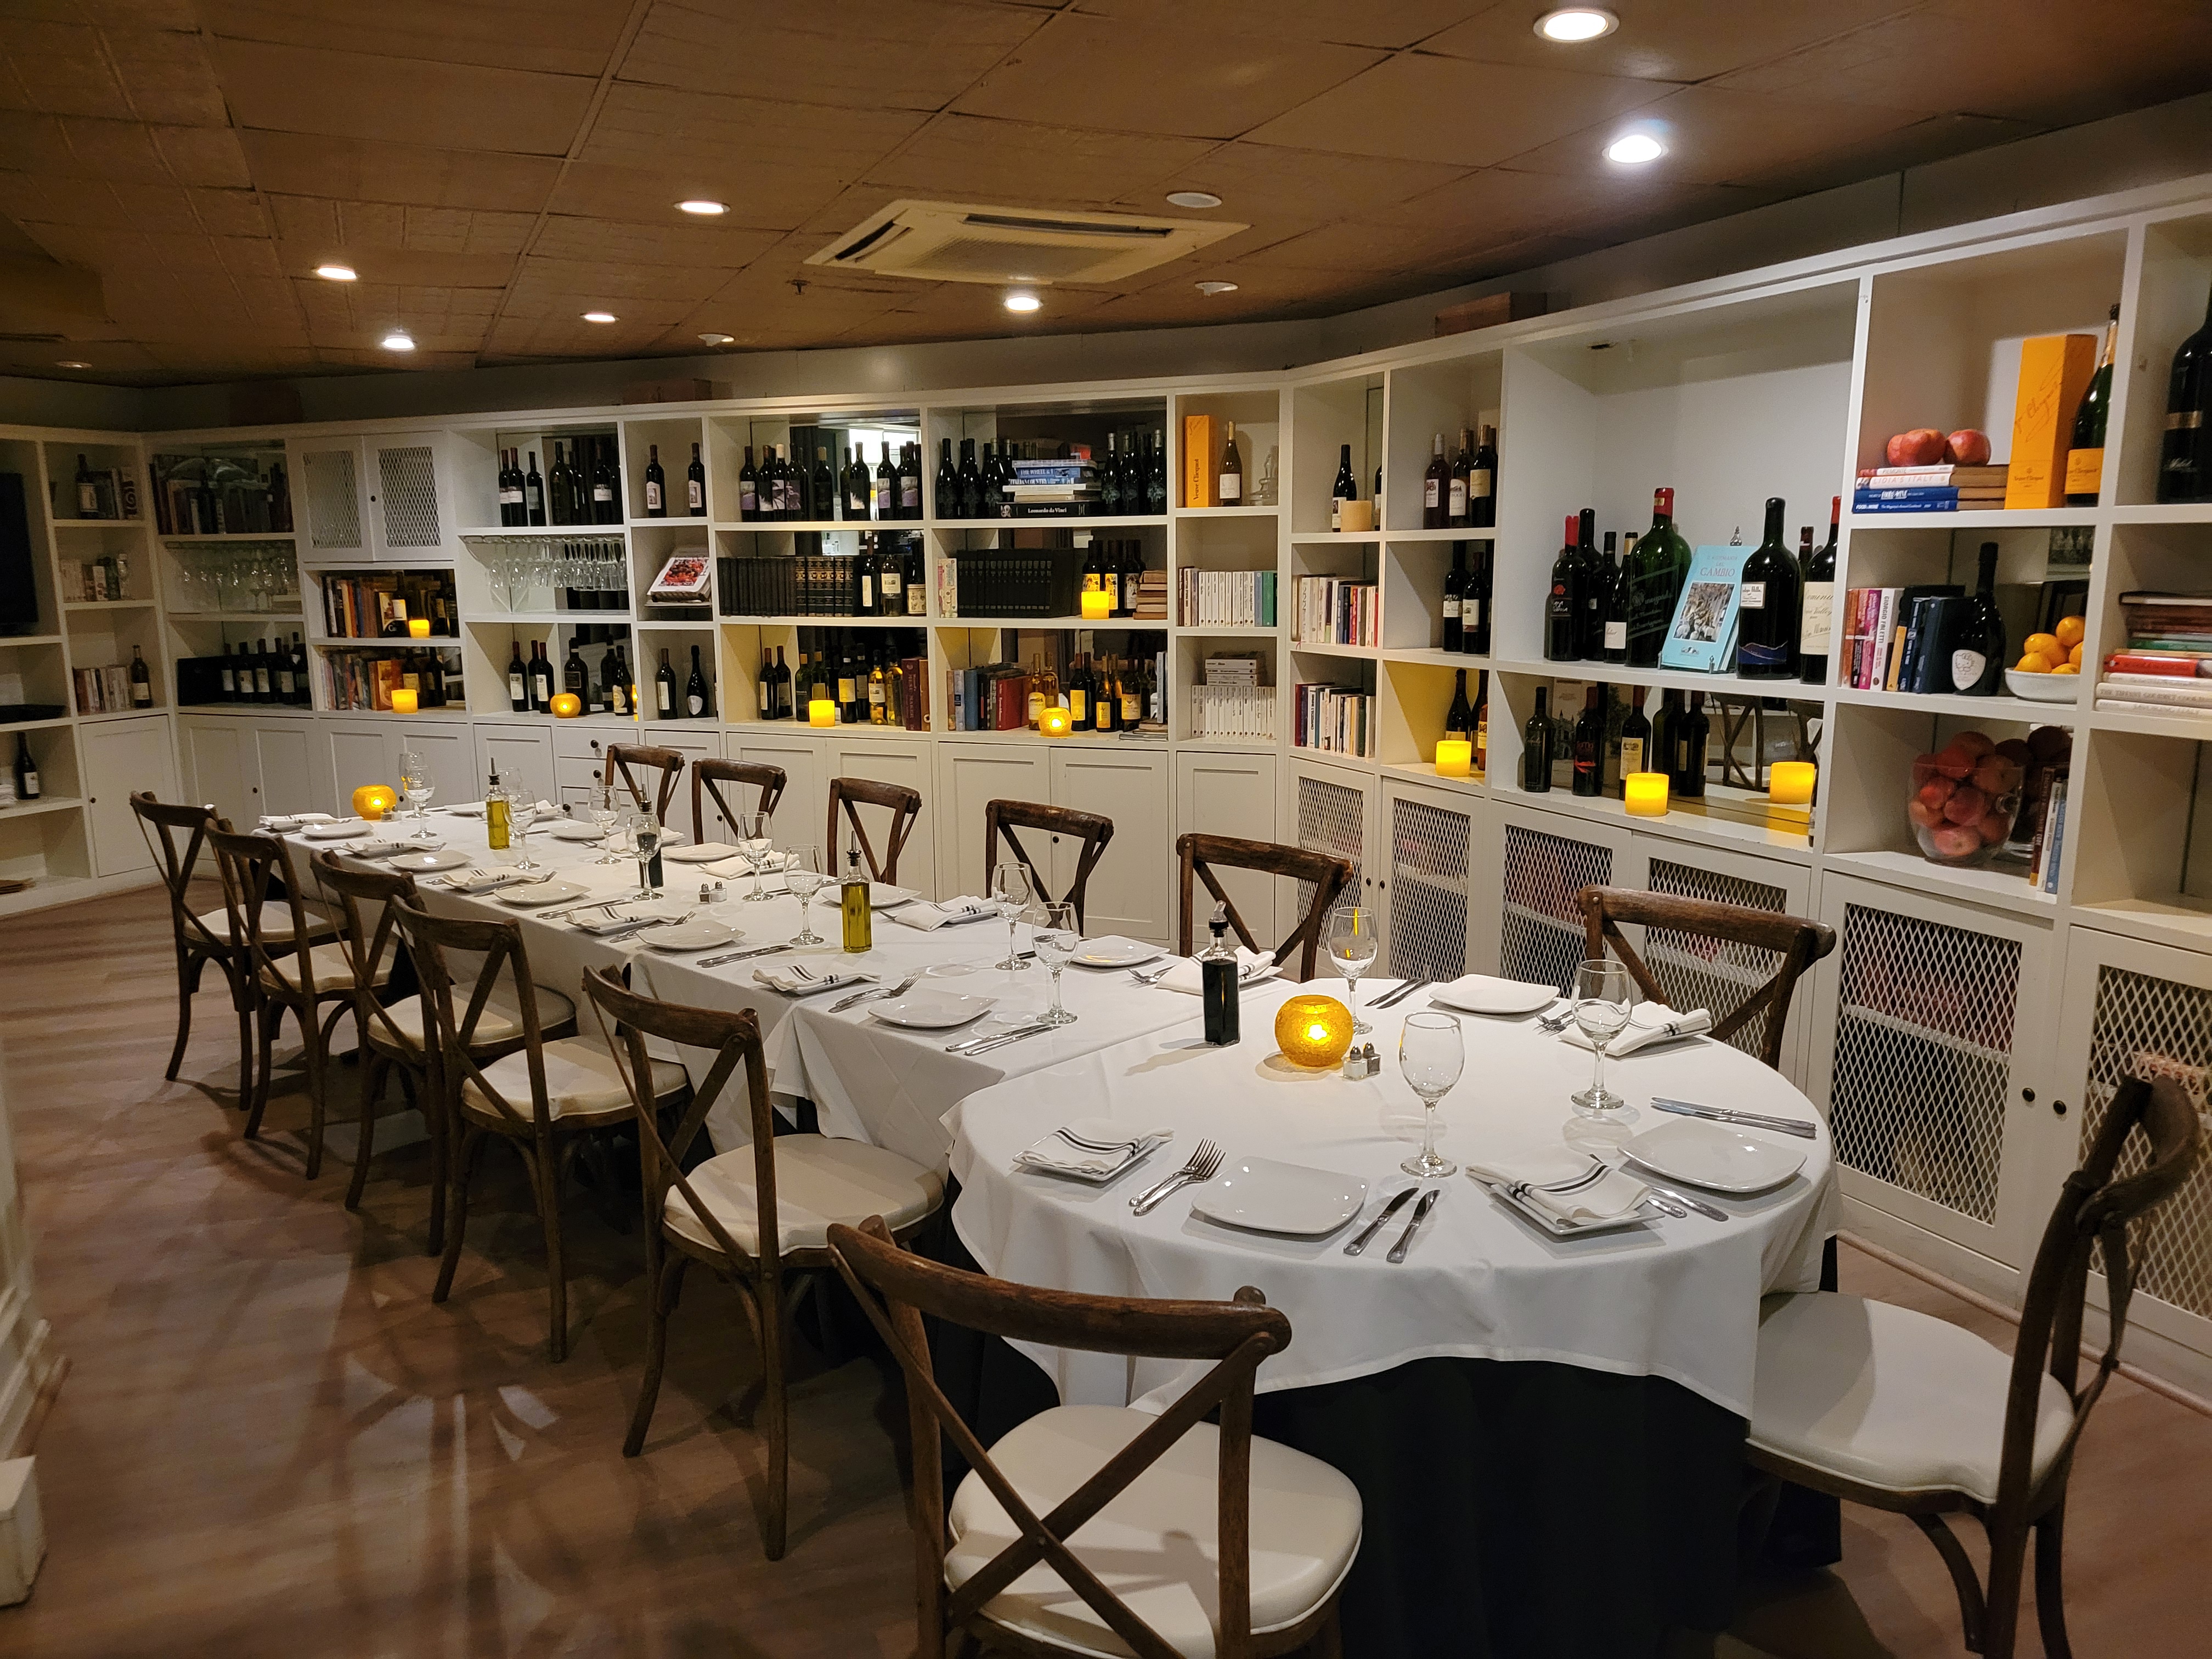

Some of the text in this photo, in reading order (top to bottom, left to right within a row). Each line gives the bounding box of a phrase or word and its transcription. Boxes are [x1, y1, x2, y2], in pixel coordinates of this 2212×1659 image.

[1873, 475, 1933, 484] LIDIA'S ITALY
[1700, 567, 1735, 577] CAMBIO
[1881, 596, 1890, 622] GIORGIO
[1877, 622, 1887, 644] FALETTI
